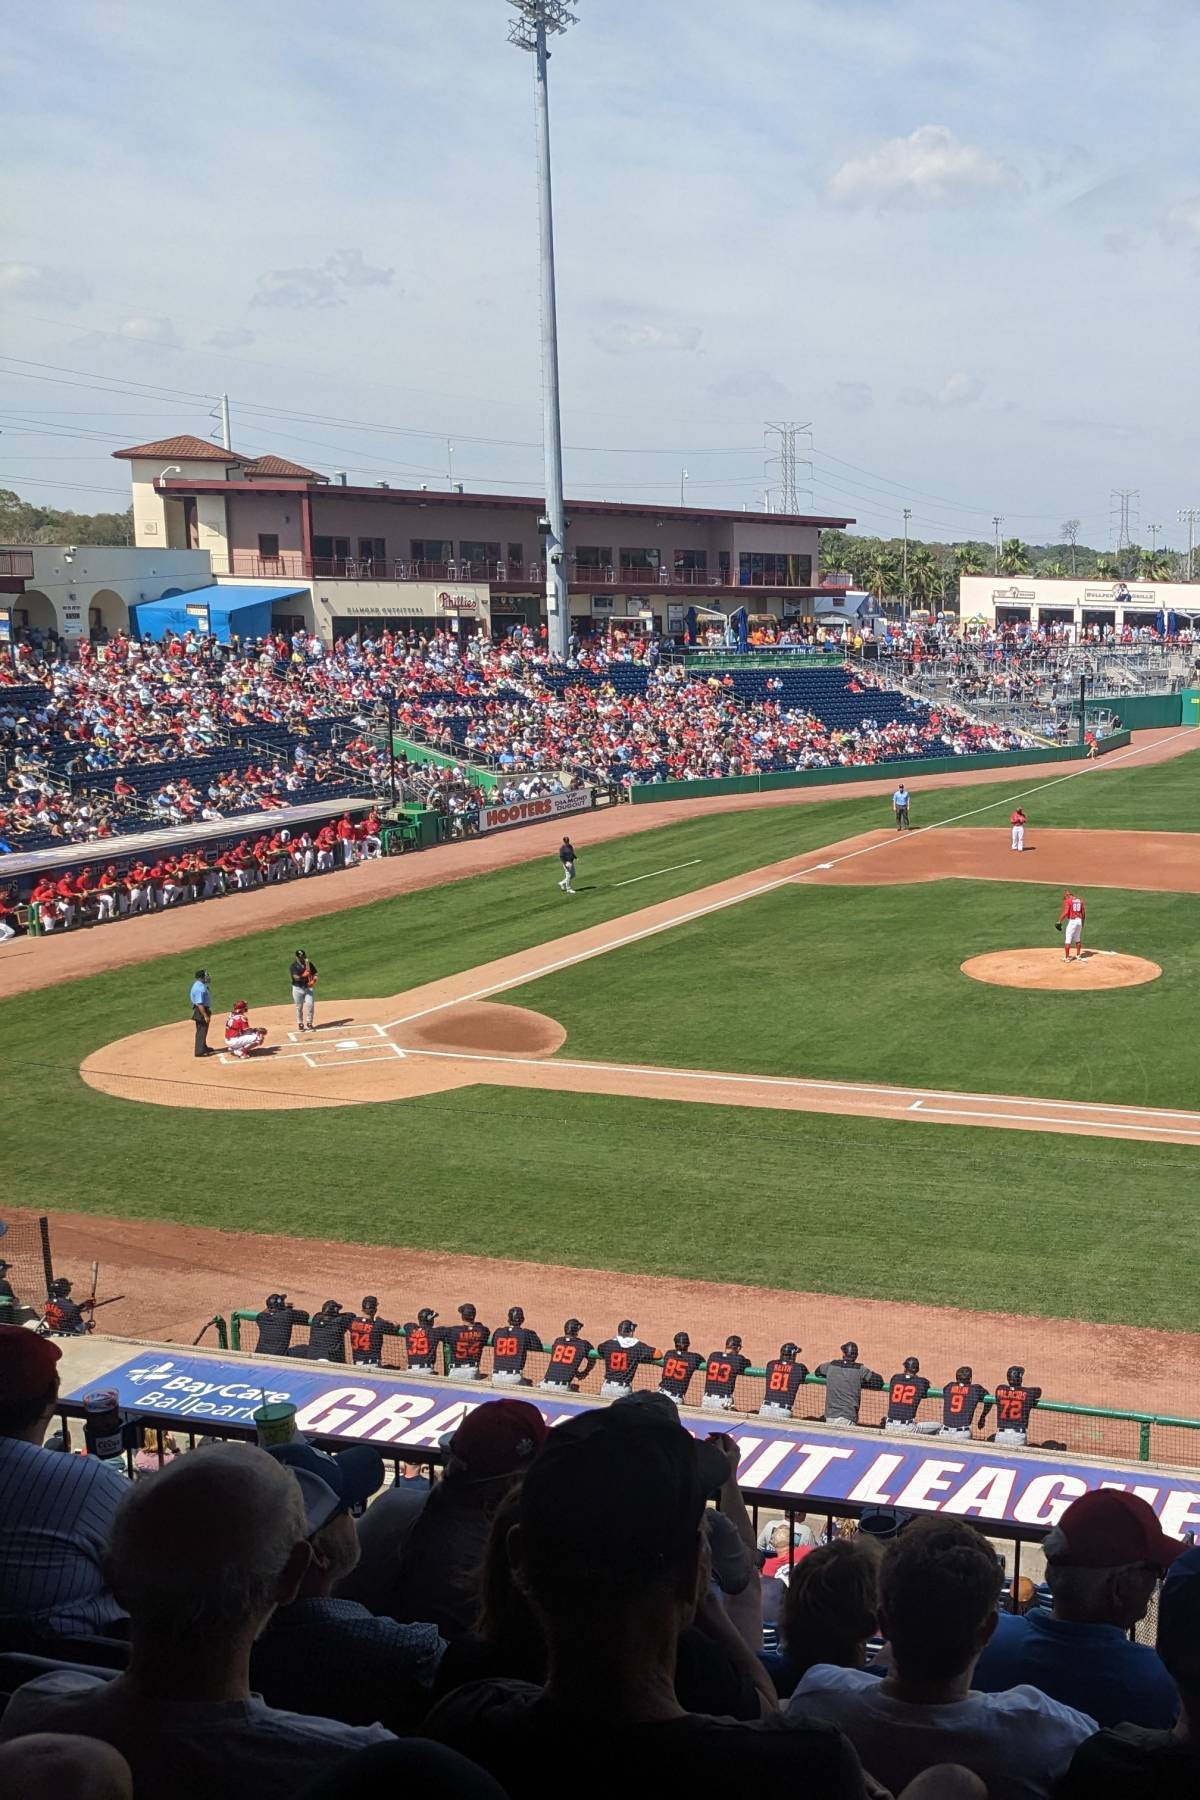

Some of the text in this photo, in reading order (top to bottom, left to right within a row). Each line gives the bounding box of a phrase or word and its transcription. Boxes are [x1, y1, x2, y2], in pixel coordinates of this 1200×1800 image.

[439, 591, 477, 610] Phillies
[554, 794, 588, 806] DIAMOND
[556, 800, 586, 811] DUGOUT
[486, 799, 552, 827] HOOTERS
[496, 1338, 518, 1356] 88
[552, 1344, 577, 1364] 89
[610, 1352, 628, 1372] 81
[662, 1358, 688, 1380] 85
[707, 1362, 732, 1384] 93
[769, 1372, 790, 1392] 81
[162, 1376, 291, 1404] BayCare
[891, 1384, 917, 1404] 82
[950, 1394, 964, 1414] 9
[1000, 1400, 1022, 1420] 72
